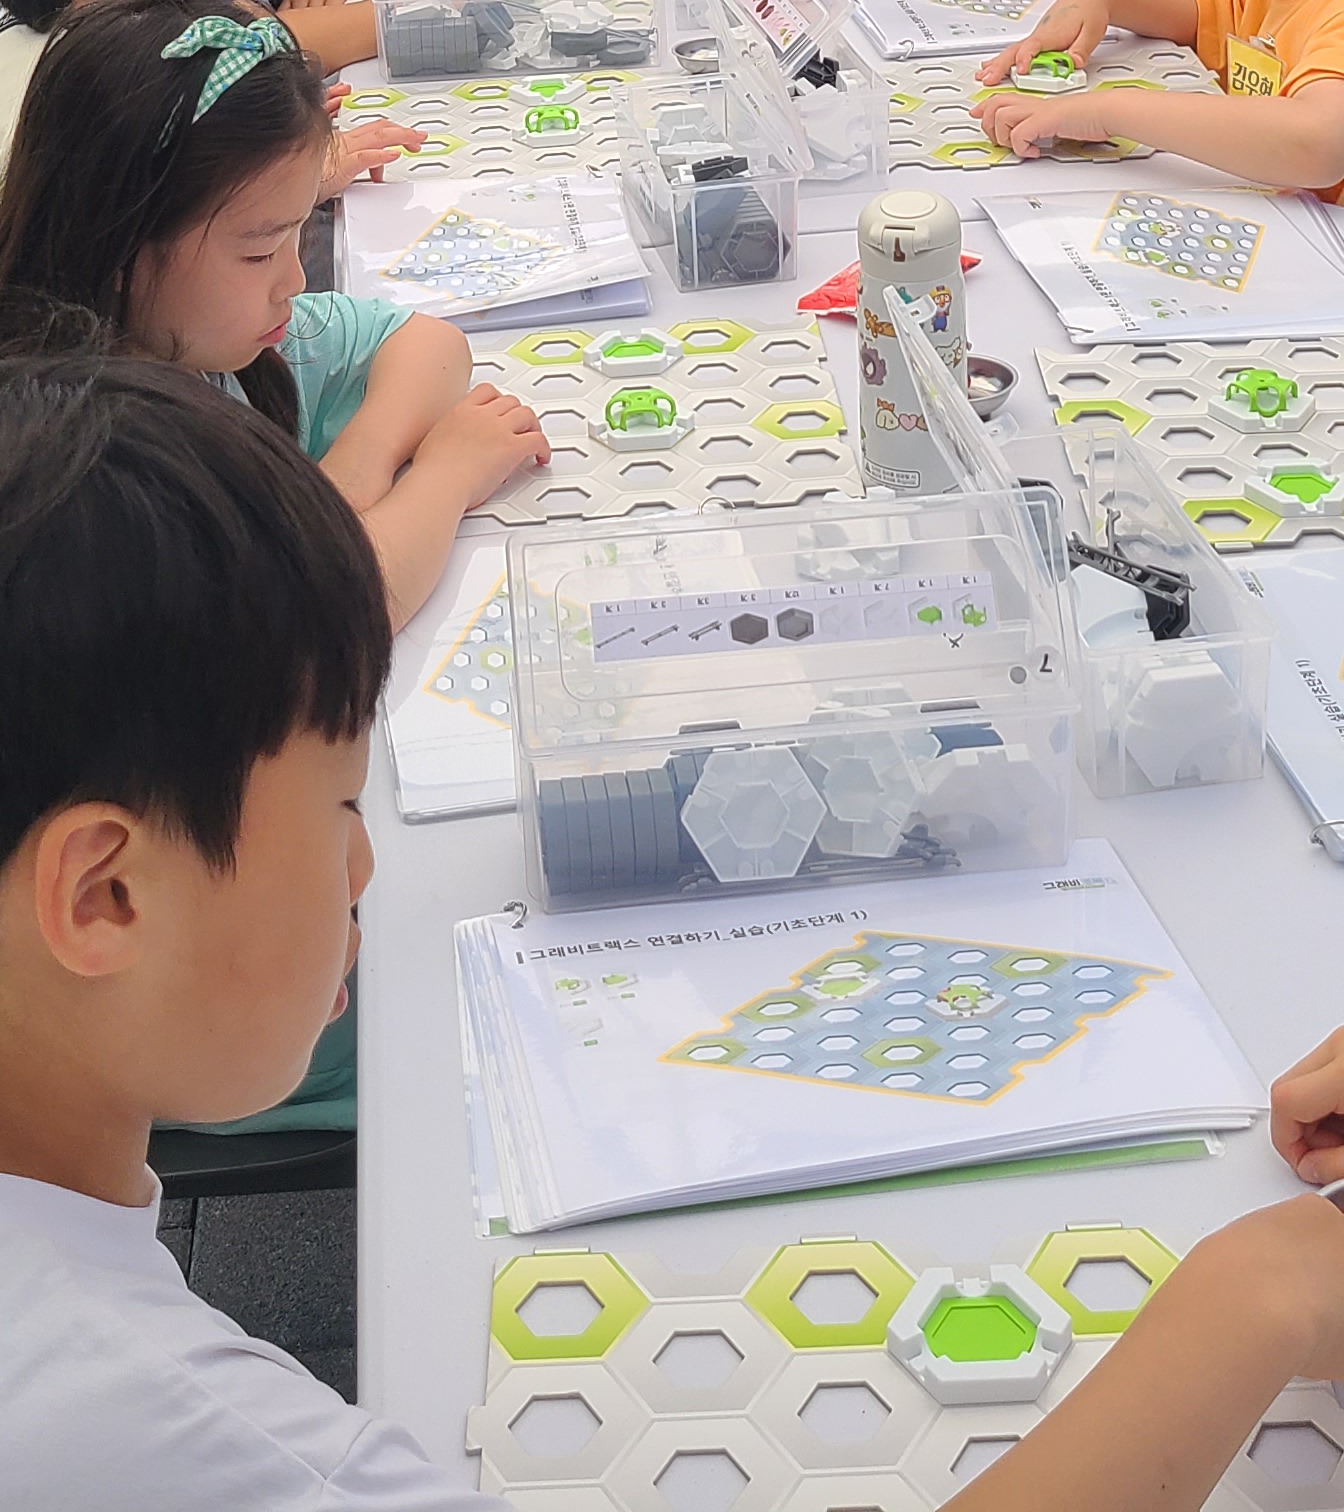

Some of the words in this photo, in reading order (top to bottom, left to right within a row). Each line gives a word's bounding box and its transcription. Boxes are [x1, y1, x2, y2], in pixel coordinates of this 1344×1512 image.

[1039, 653, 1053, 673] 7
[529, 936, 642, 961] 그래비트랙스
[849, 908, 869, 921] 1)
